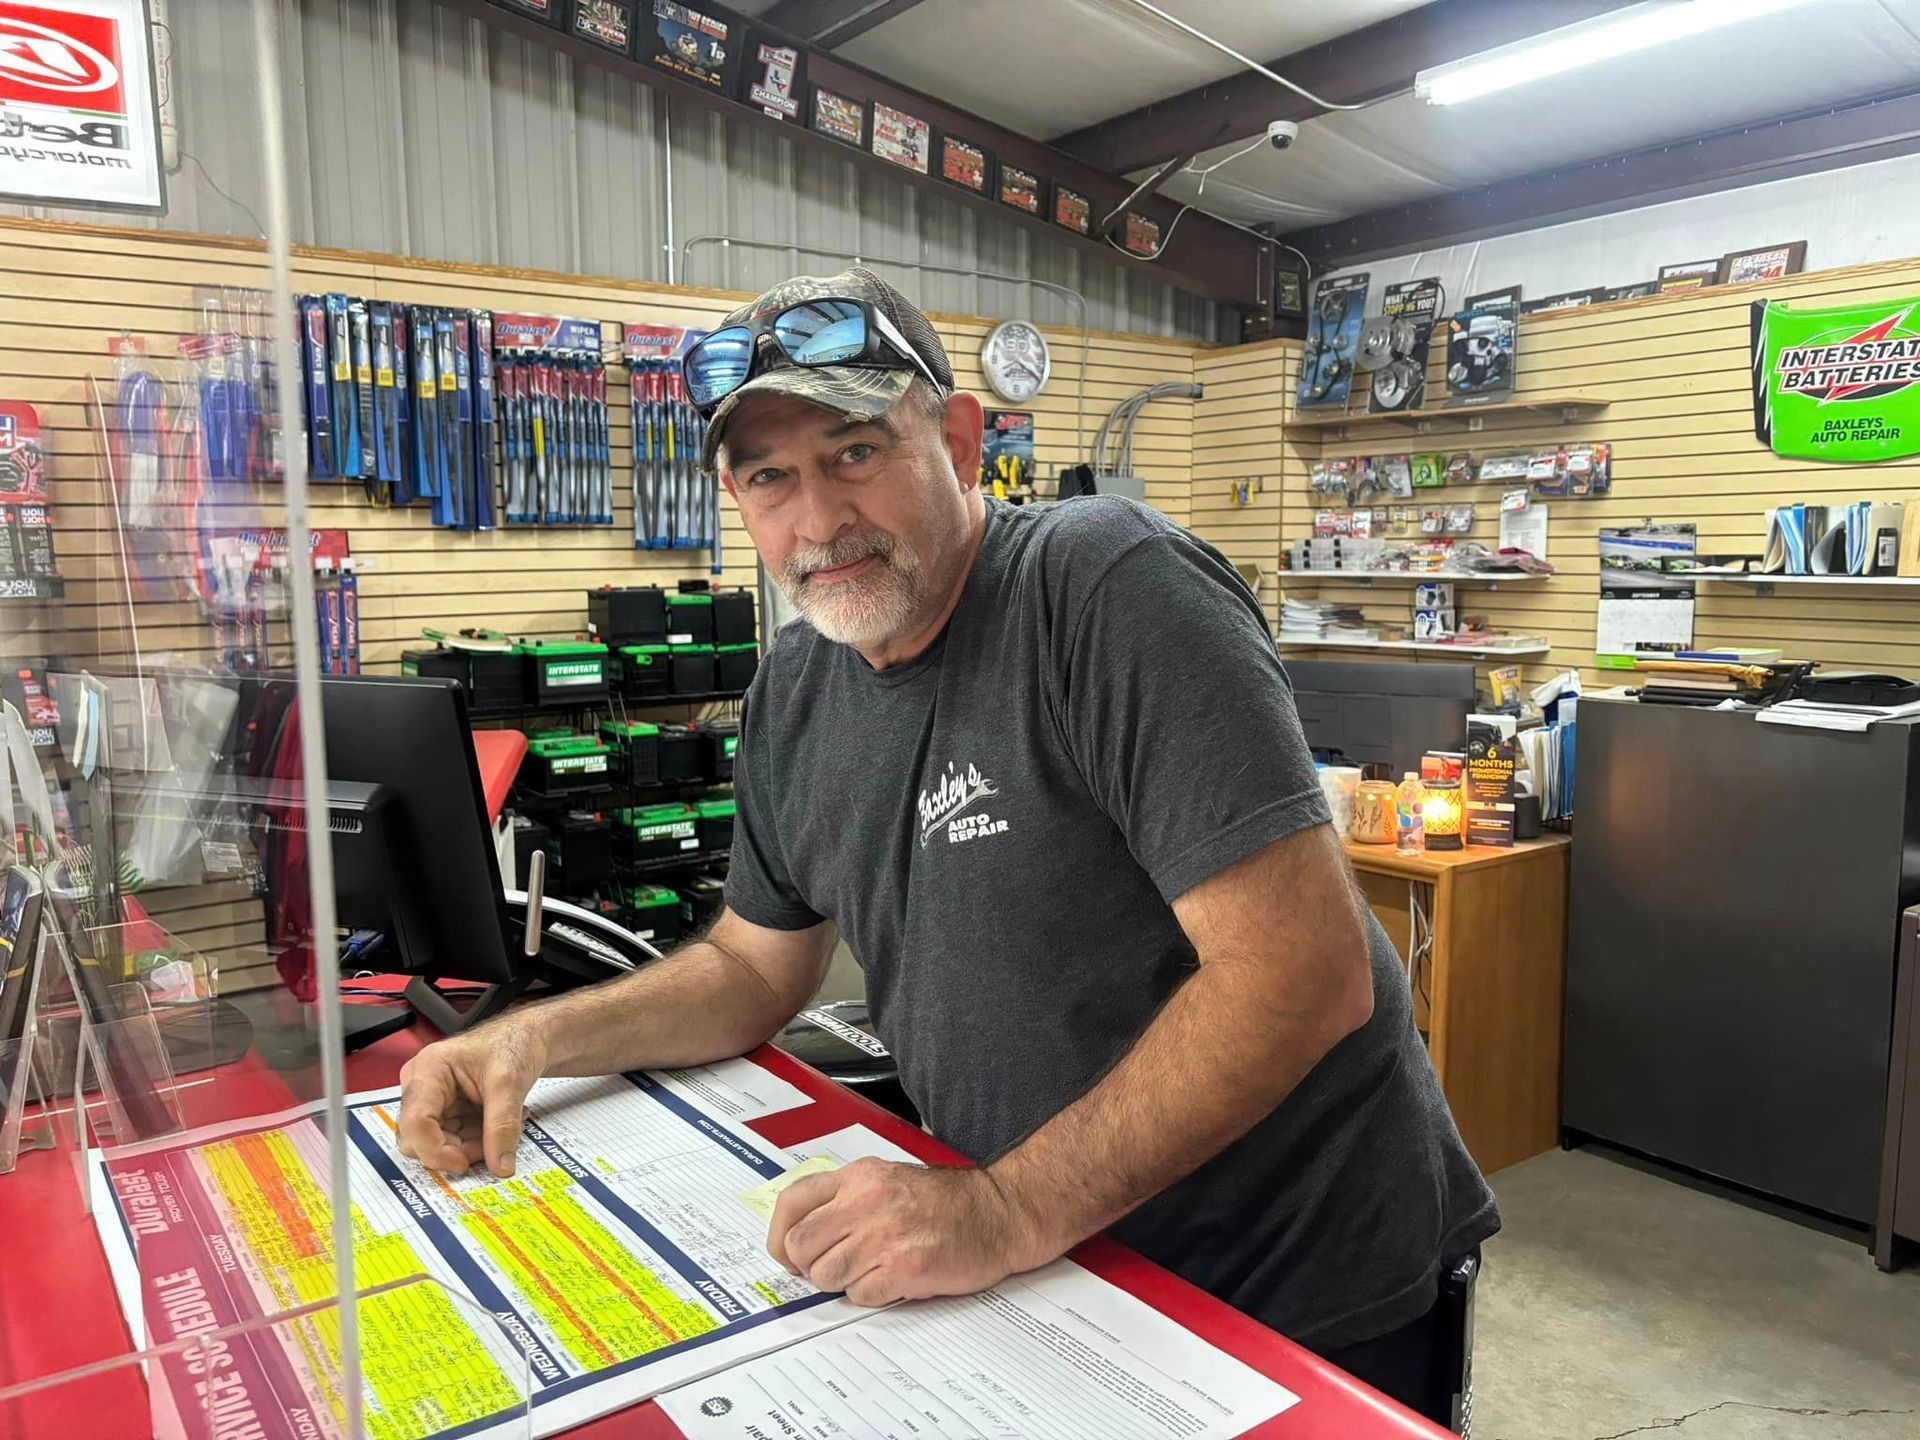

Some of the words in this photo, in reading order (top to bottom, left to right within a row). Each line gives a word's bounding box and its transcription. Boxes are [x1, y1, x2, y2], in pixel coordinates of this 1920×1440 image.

[753, 88, 797, 113] CHAMPION
[1384, 302, 1416, 316] STOPING
[499, 324, 551, 337] Duralast
[569, 326, 595, 336] WIPER
[627, 333, 677, 347] Duralast
[1781, 340, 1920, 368] INTERSTAT
[1783, 362, 1920, 388] BATTERIES
[1824, 417, 1883, 431] BAXLEYS
[1810, 430, 1847, 444] AUTO
[1850, 428, 1900, 442] REPAIR
[548, 664, 599, 676] INTERSTATE
[1487, 747, 1497, 759] 6
[552, 756, 606, 769] INTERSTATE
[1469, 759, 1513, 769] MONTHS
[640, 822, 691, 836] INTERSTATE
[948, 814, 990, 832] AUTO
[948, 820, 1010, 843] REPAIR
[547, 1146, 589, 1178] SATURDAY
[112, 1169, 169, 1240] Duralast
[391, 1179, 431, 1218] THURSDAY
[165, 1196, 184, 1223] PROVEN
[210, 1234, 238, 1273] TUESDAY
[694, 1280, 743, 1316] FRIDAY
[497, 1312, 562, 1380] WEDNESDAY
[767, 1410, 796, 1436] Sheet
[924, 1410, 940, 1423] TECH
